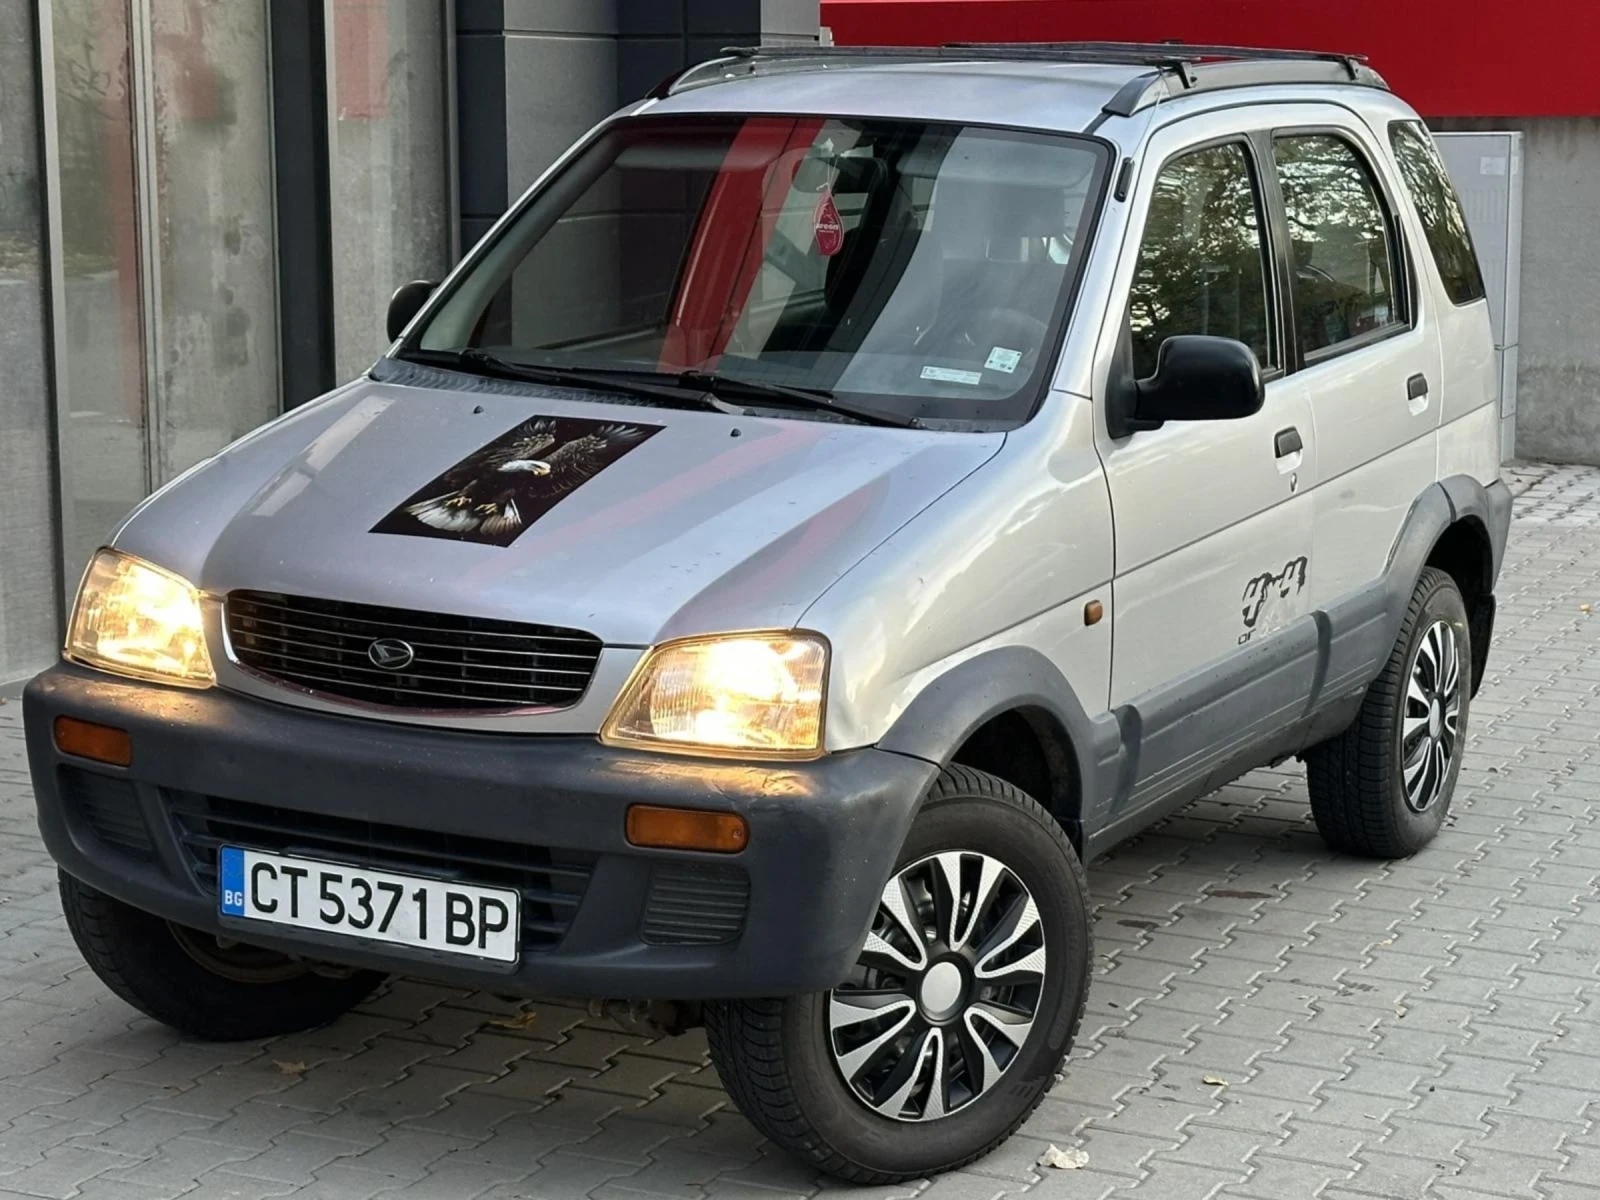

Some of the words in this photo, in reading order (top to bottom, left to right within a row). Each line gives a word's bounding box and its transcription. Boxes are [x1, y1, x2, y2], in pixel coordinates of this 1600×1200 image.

[224, 889, 243, 907] BG
[251, 861, 308, 918] CT
[319, 871, 428, 940] 5371
[445, 891, 508, 949] BP
